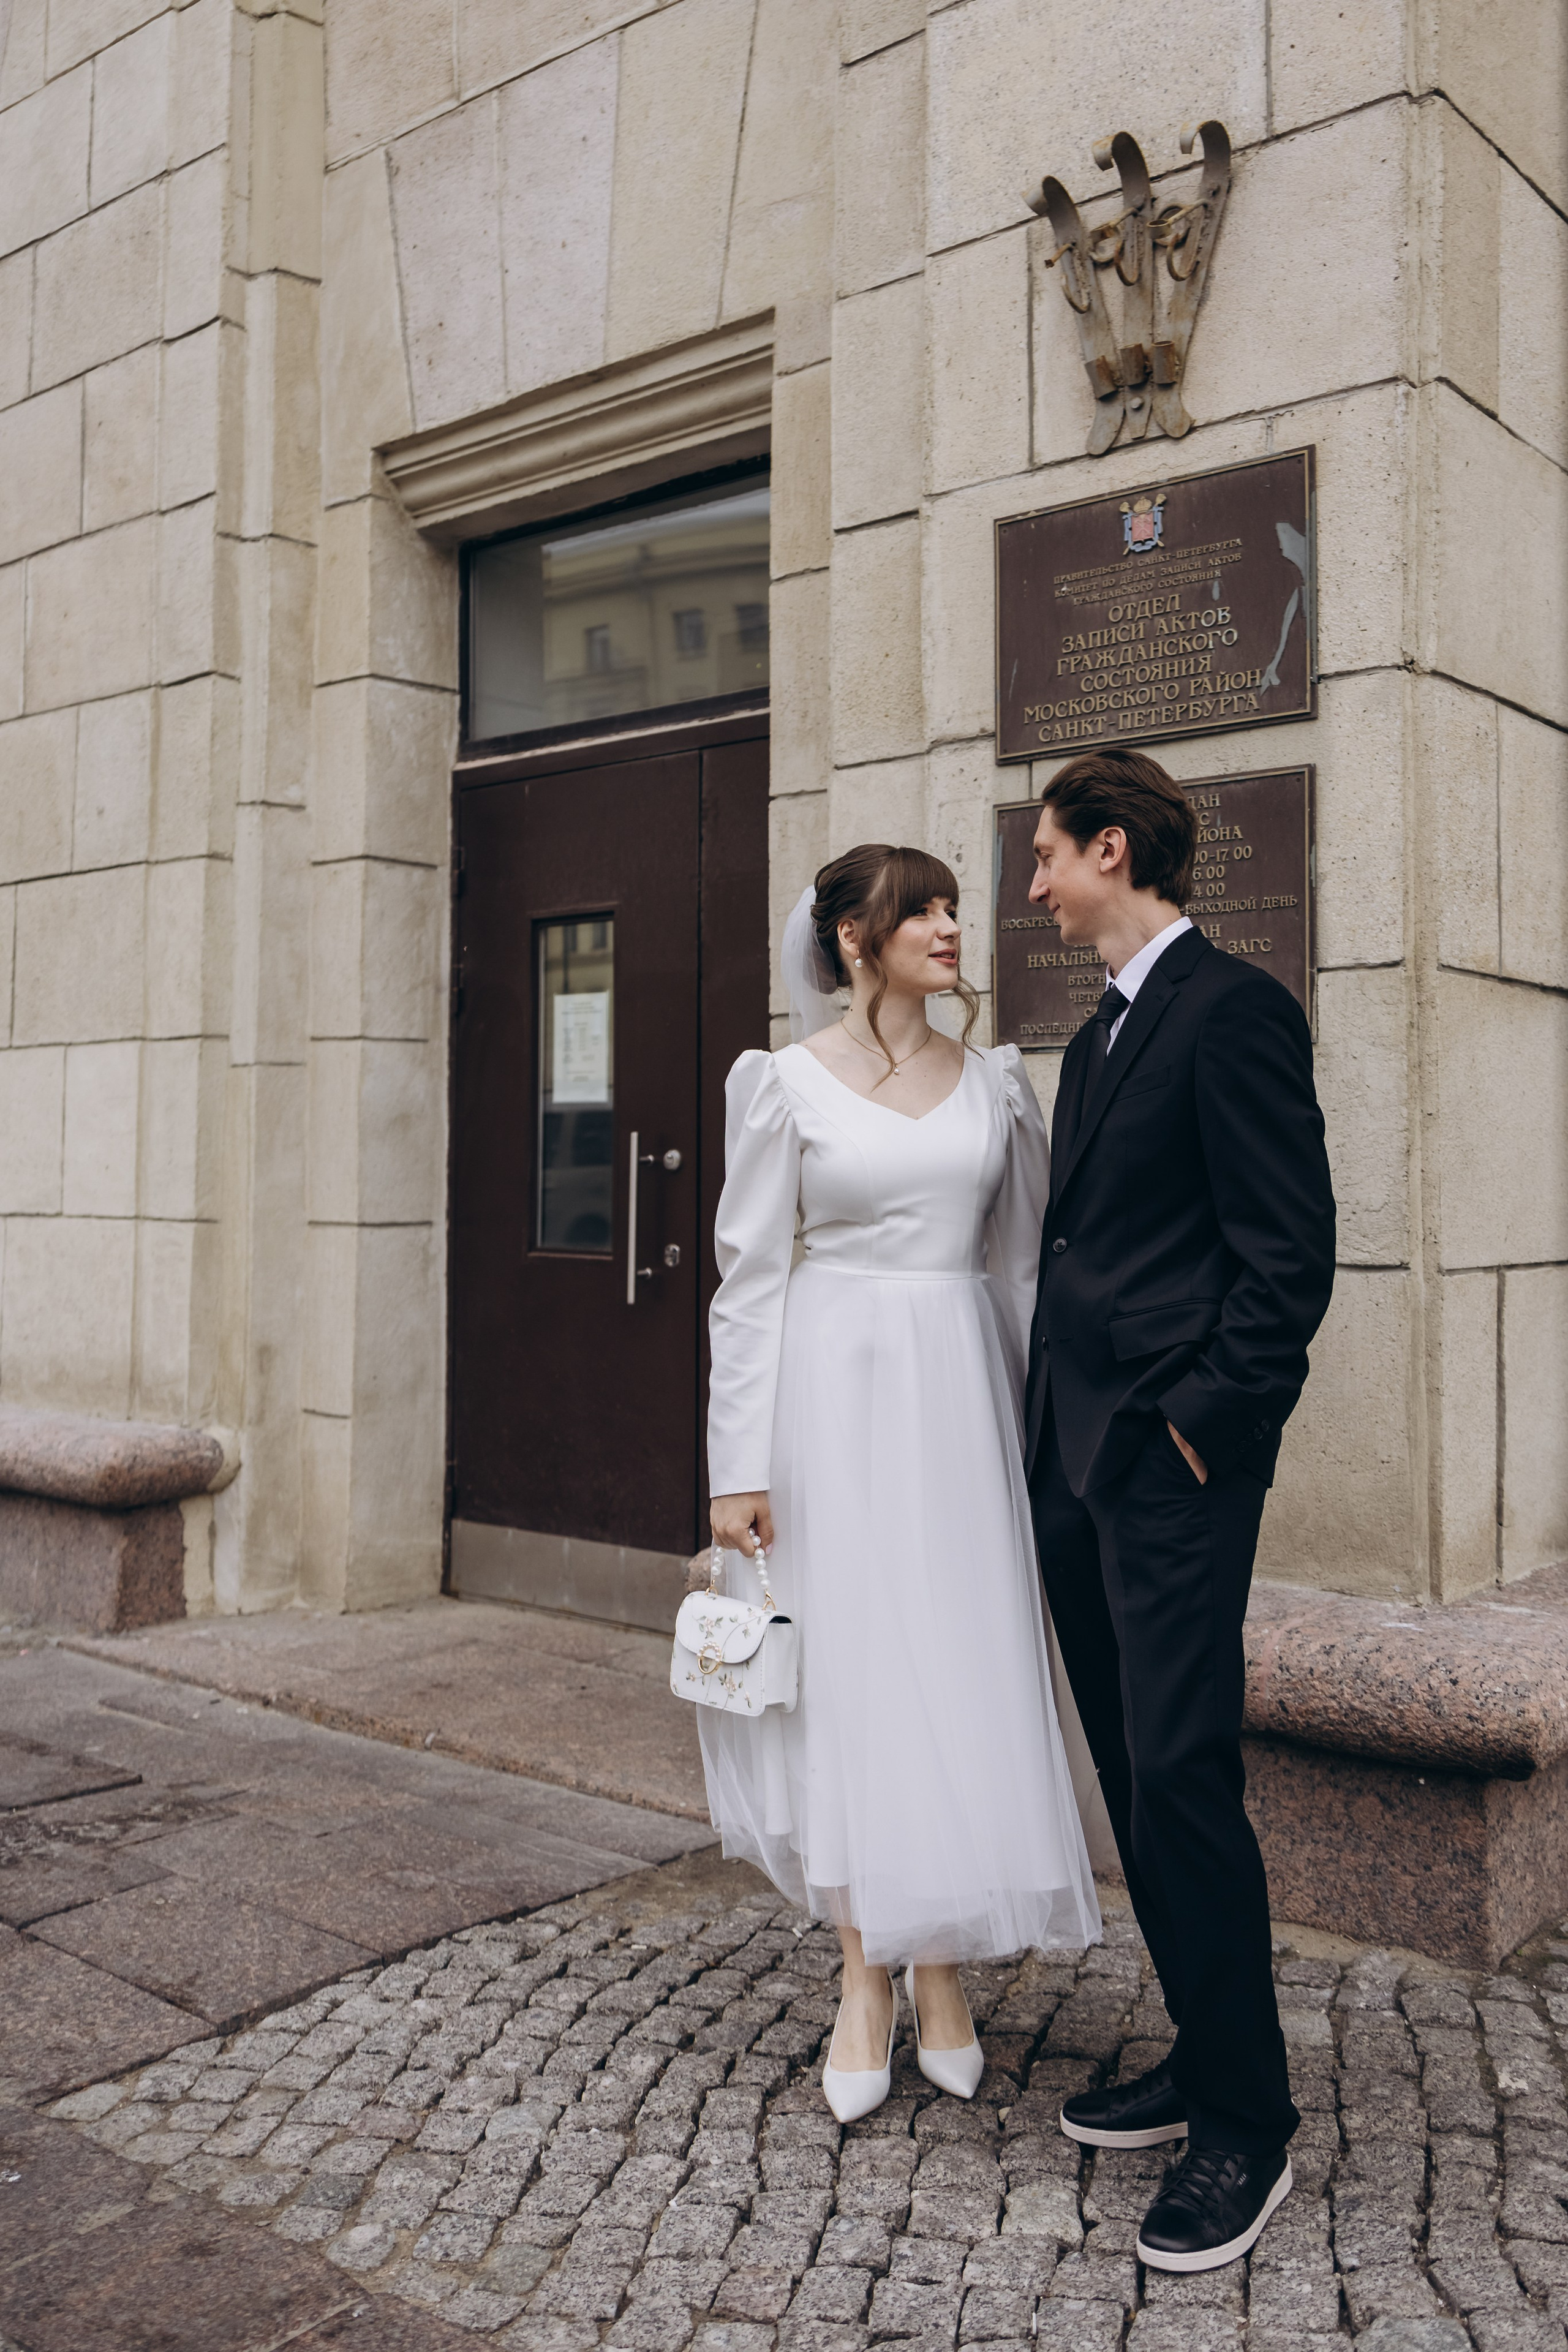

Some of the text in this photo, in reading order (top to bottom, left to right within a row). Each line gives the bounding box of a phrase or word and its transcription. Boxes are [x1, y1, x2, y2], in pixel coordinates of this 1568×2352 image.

[1053, 538, 1243, 584] ПРАВИТЕЛЬСТВО САНКТ-ПЕТЕРБУРГА
[1054, 552, 1242, 598] КОМИТЕТ ПО ДЕЛАМ ЗАПИСИ АКТОВ
[1074, 569, 1222, 606] ГРАЖДАНСКОГО СОСТОЯНИЯ
[1108, 593, 1182, 623] ОТДЕЛ
[1061, 606, 1232, 654] ЗАПИСИ АКТОВ
[1057, 628, 1238, 676] ГРАЖДАНСКОГО
[1080, 654, 1213, 693] СОСТОЯНИЯ
[1023, 668, 1263, 725] МОСКОВСКОГО РАЙОН
[1038, 692, 1261, 743] САНКТ-ПЕТЕРБУРГА
[1197, 826, 1244, 844] ЙОНА
[1261, 895, 1298, 910] ДЕНЬ
[1227, 938, 1272, 954] ЗАГС
[1068, 973, 1106, 986] ВТОРН
[1069, 991, 1104, 1003] ЧЕТВ
